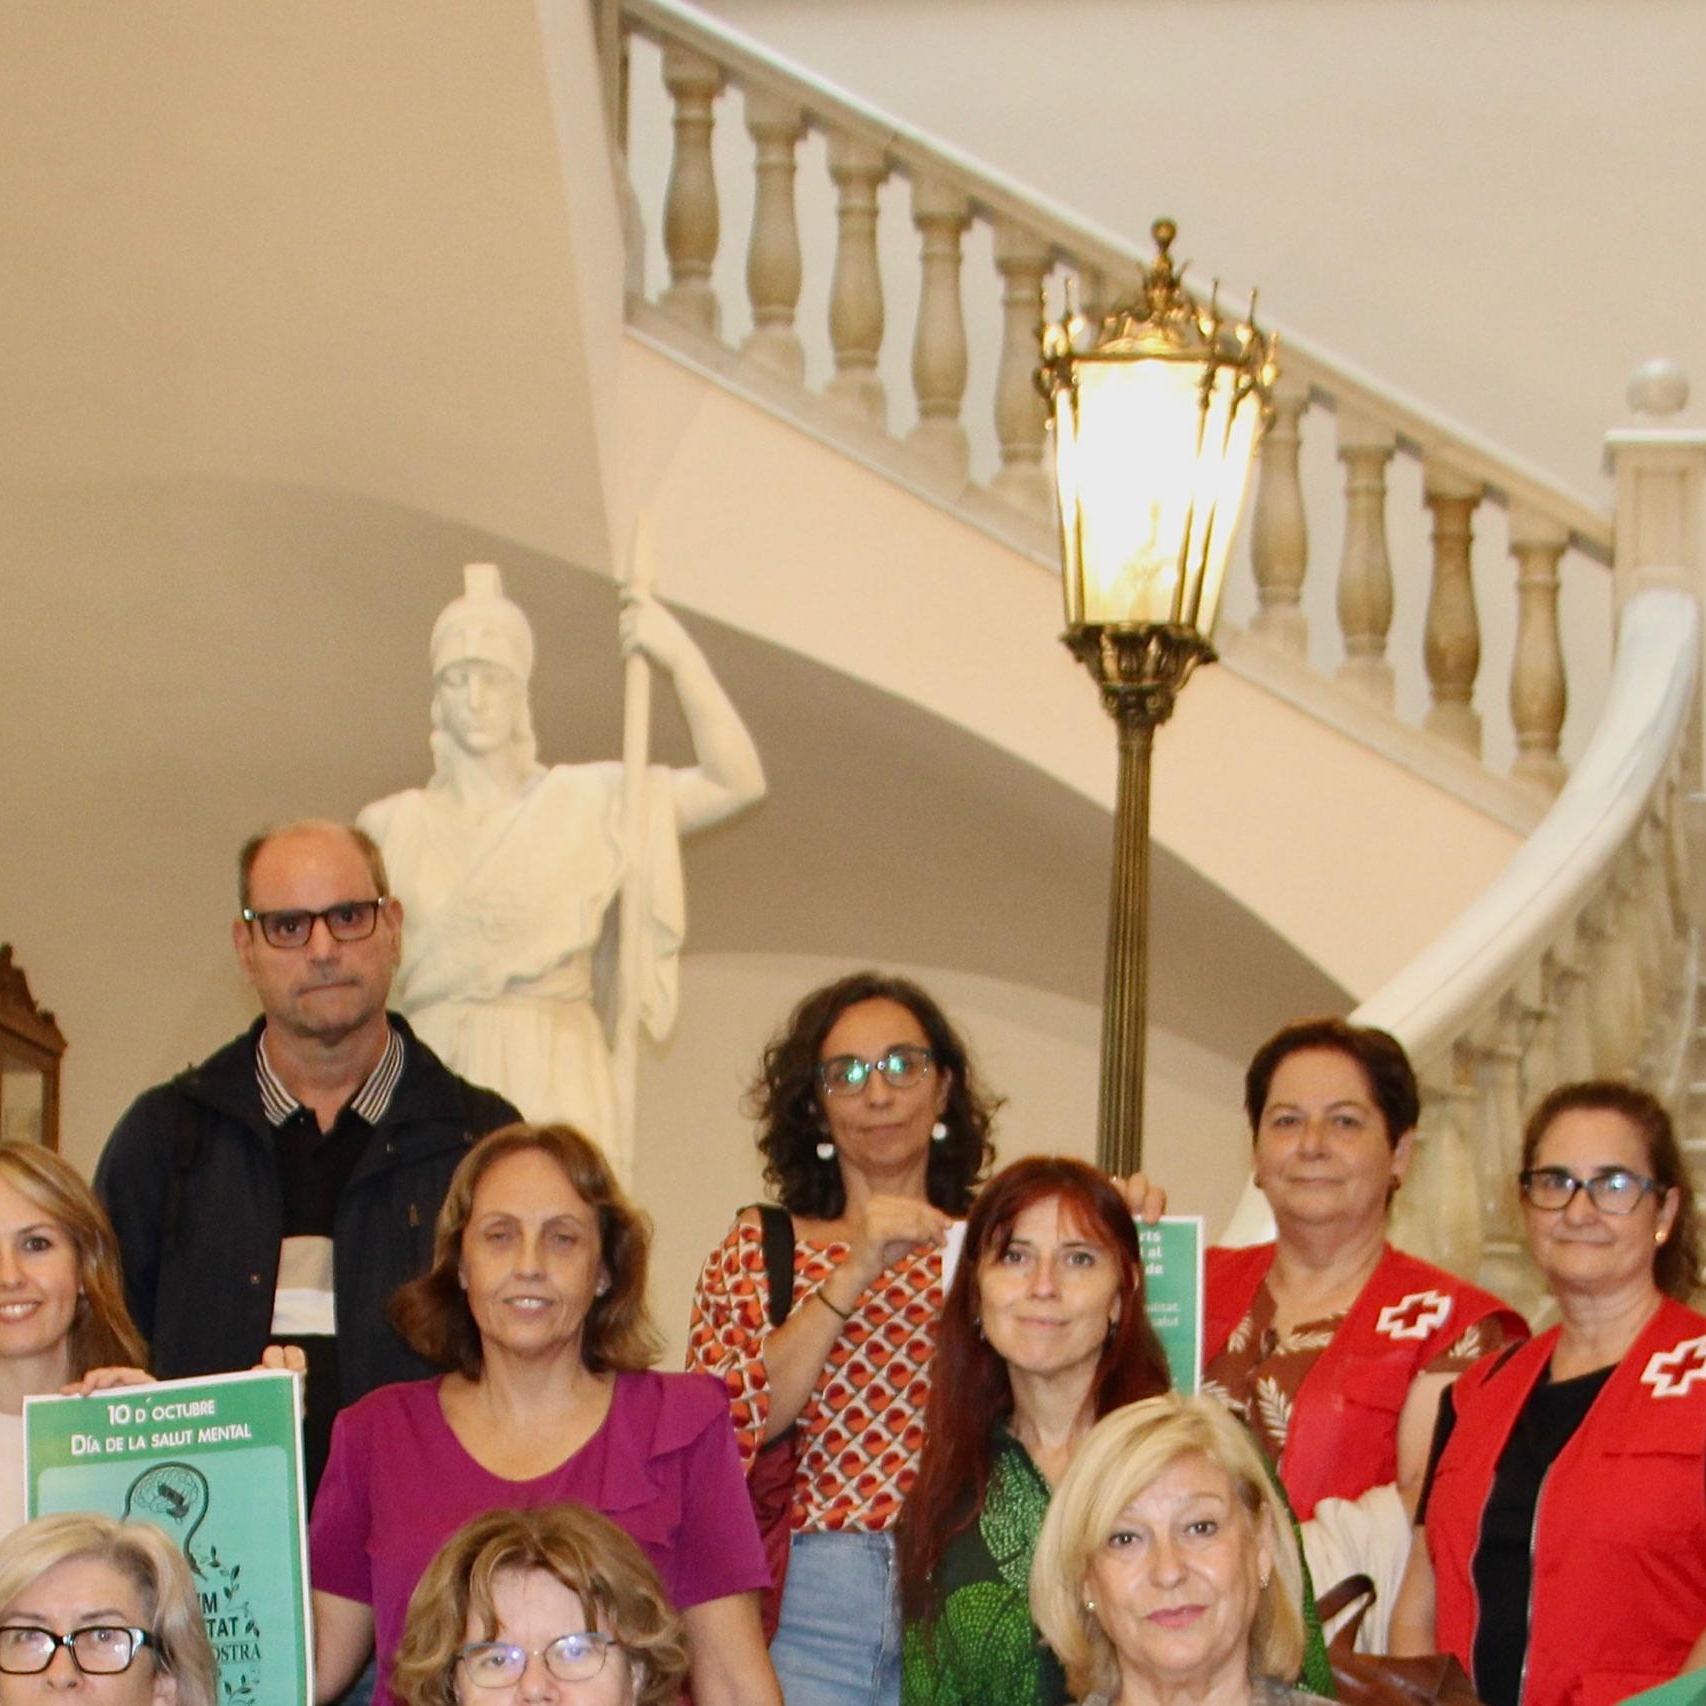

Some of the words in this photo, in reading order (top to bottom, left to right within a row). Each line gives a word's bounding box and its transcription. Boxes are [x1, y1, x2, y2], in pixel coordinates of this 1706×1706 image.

[107, 1404, 131, 1425] 10
[105, 1436, 124, 1453] DE
[128, 1435, 146, 1451] LA
[151, 1430, 193, 1448] SALUT
[197, 1423, 253, 1444] MENTAL
